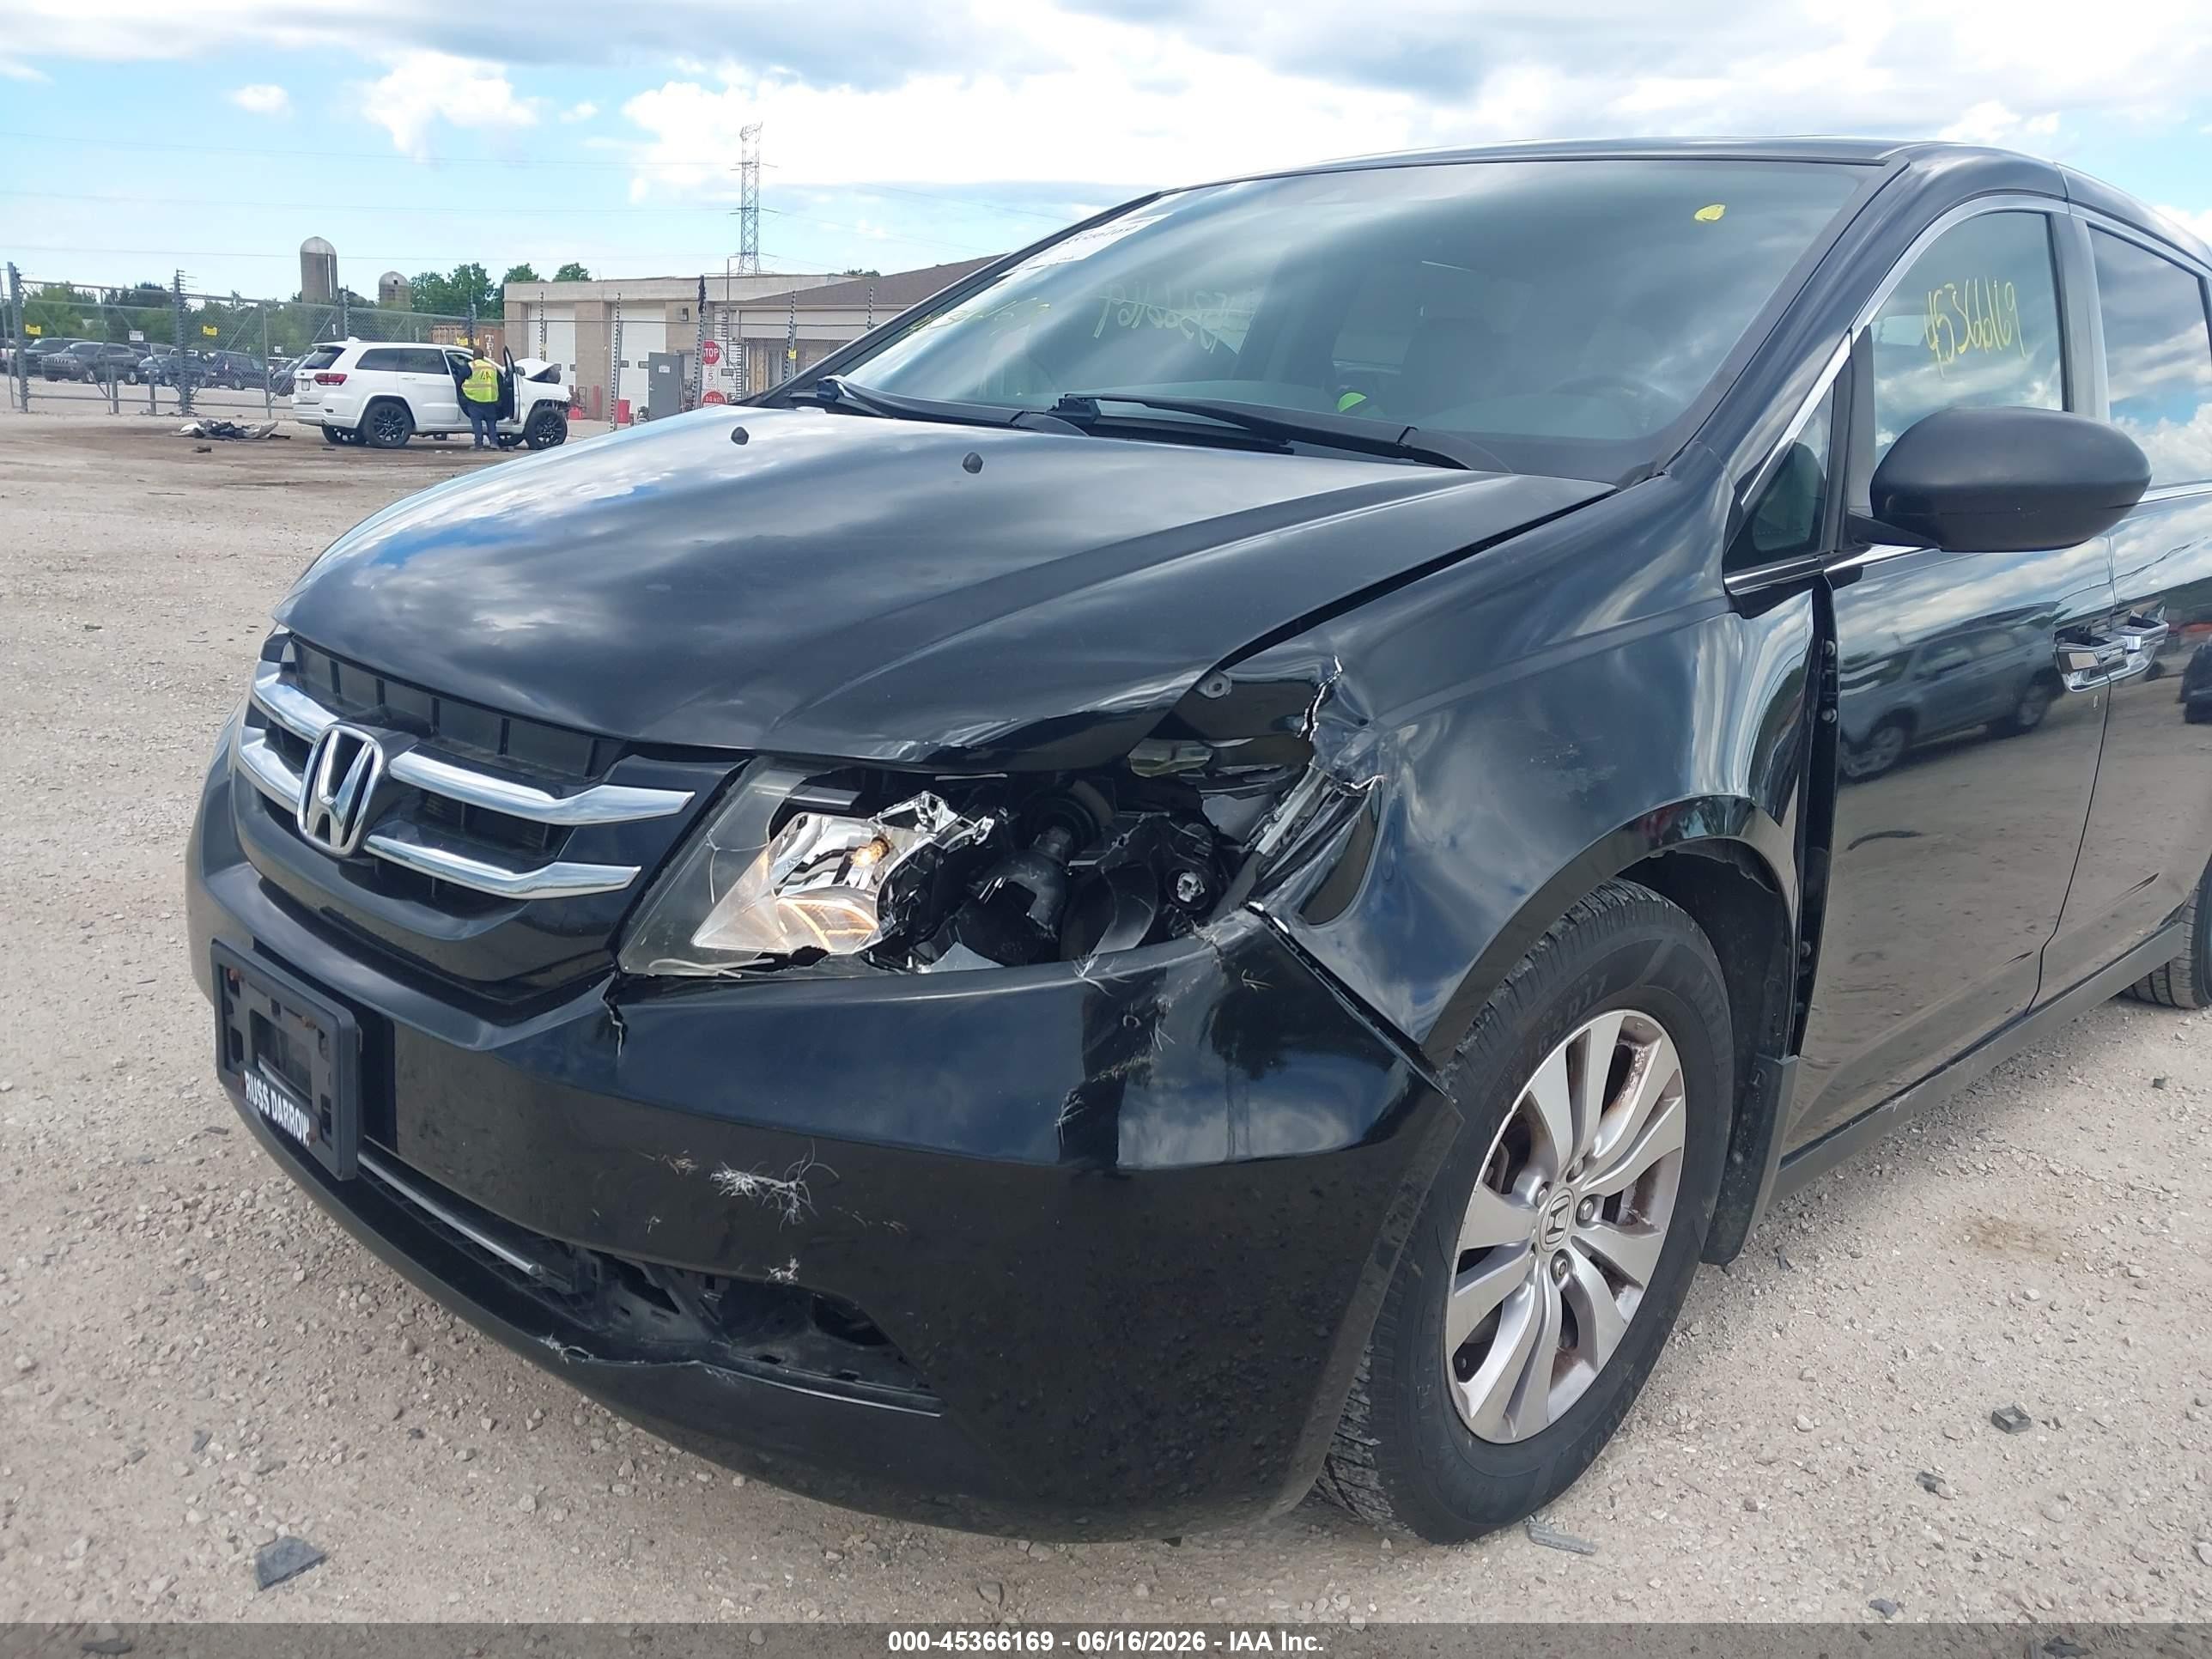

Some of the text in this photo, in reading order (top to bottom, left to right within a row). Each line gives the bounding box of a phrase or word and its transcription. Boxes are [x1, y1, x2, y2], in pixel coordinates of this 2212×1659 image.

[484, 334, 495, 362] TRI
[708, 372, 714, 381] 5
[244, 1069, 270, 1115] RUSS
